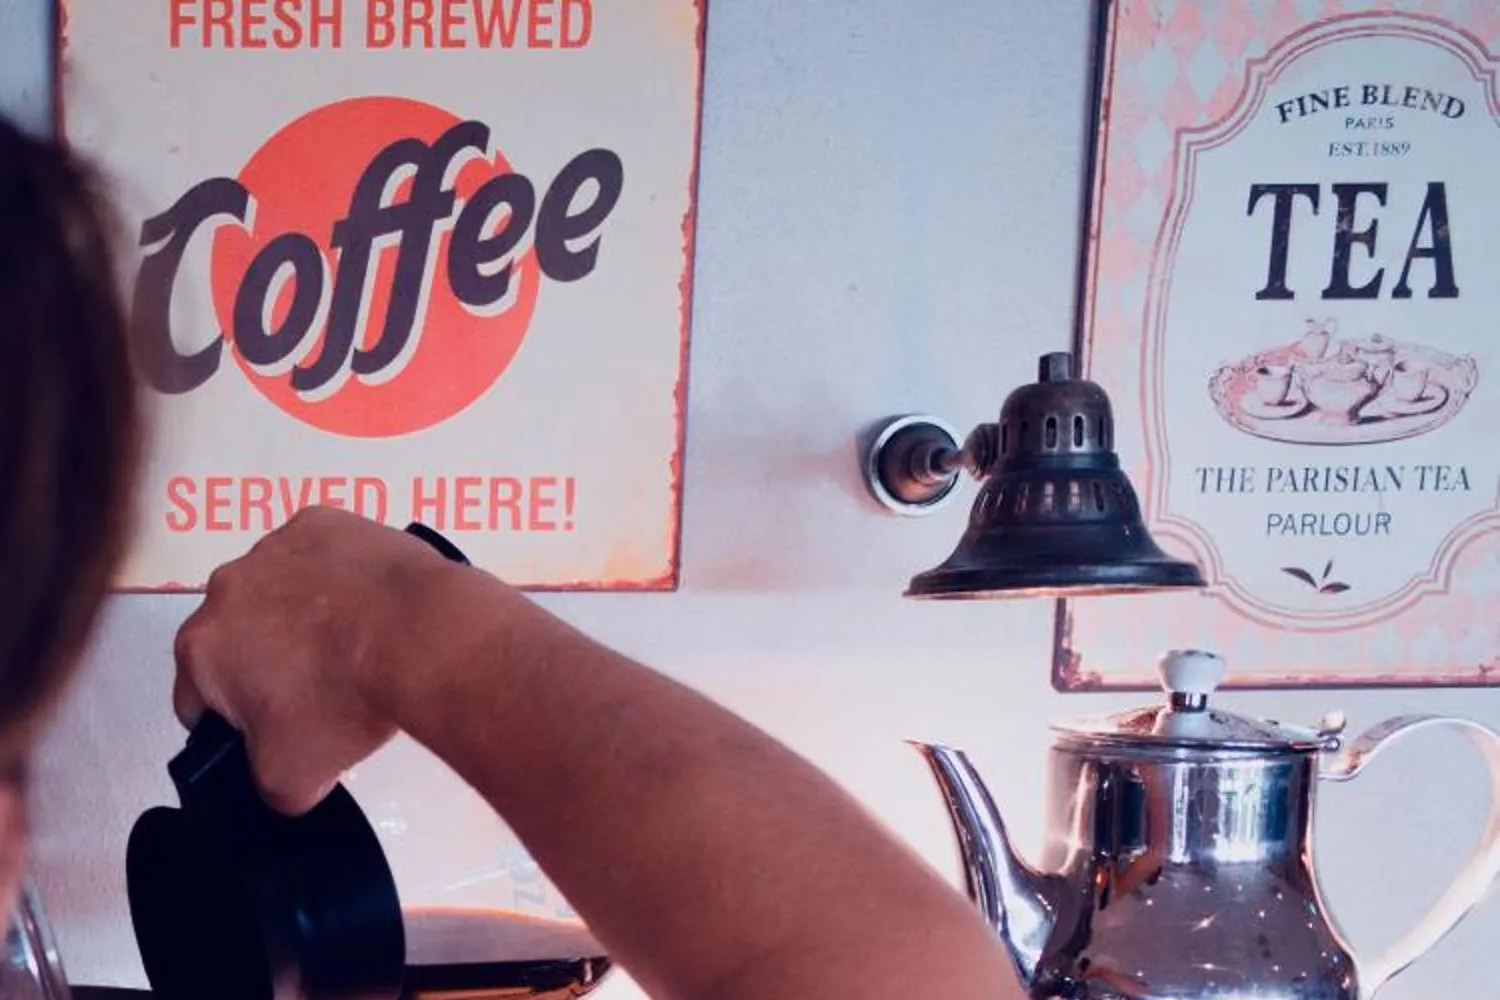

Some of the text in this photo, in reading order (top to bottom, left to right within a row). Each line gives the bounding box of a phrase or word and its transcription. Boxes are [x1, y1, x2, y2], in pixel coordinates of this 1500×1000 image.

[169, 0, 594, 49] FRESH BREWED
[1275, 84, 1466, 124] FINE BLEND
[1345, 116, 1395, 130] PARIS
[128, 119, 624, 397] Coffee
[1246, 181, 1460, 301] TEA
[1196, 464, 1472, 494] THE PARISIAN TEA
[411, 475, 577, 532] HERE!
[1266, 511, 1393, 538] PARLOUR
